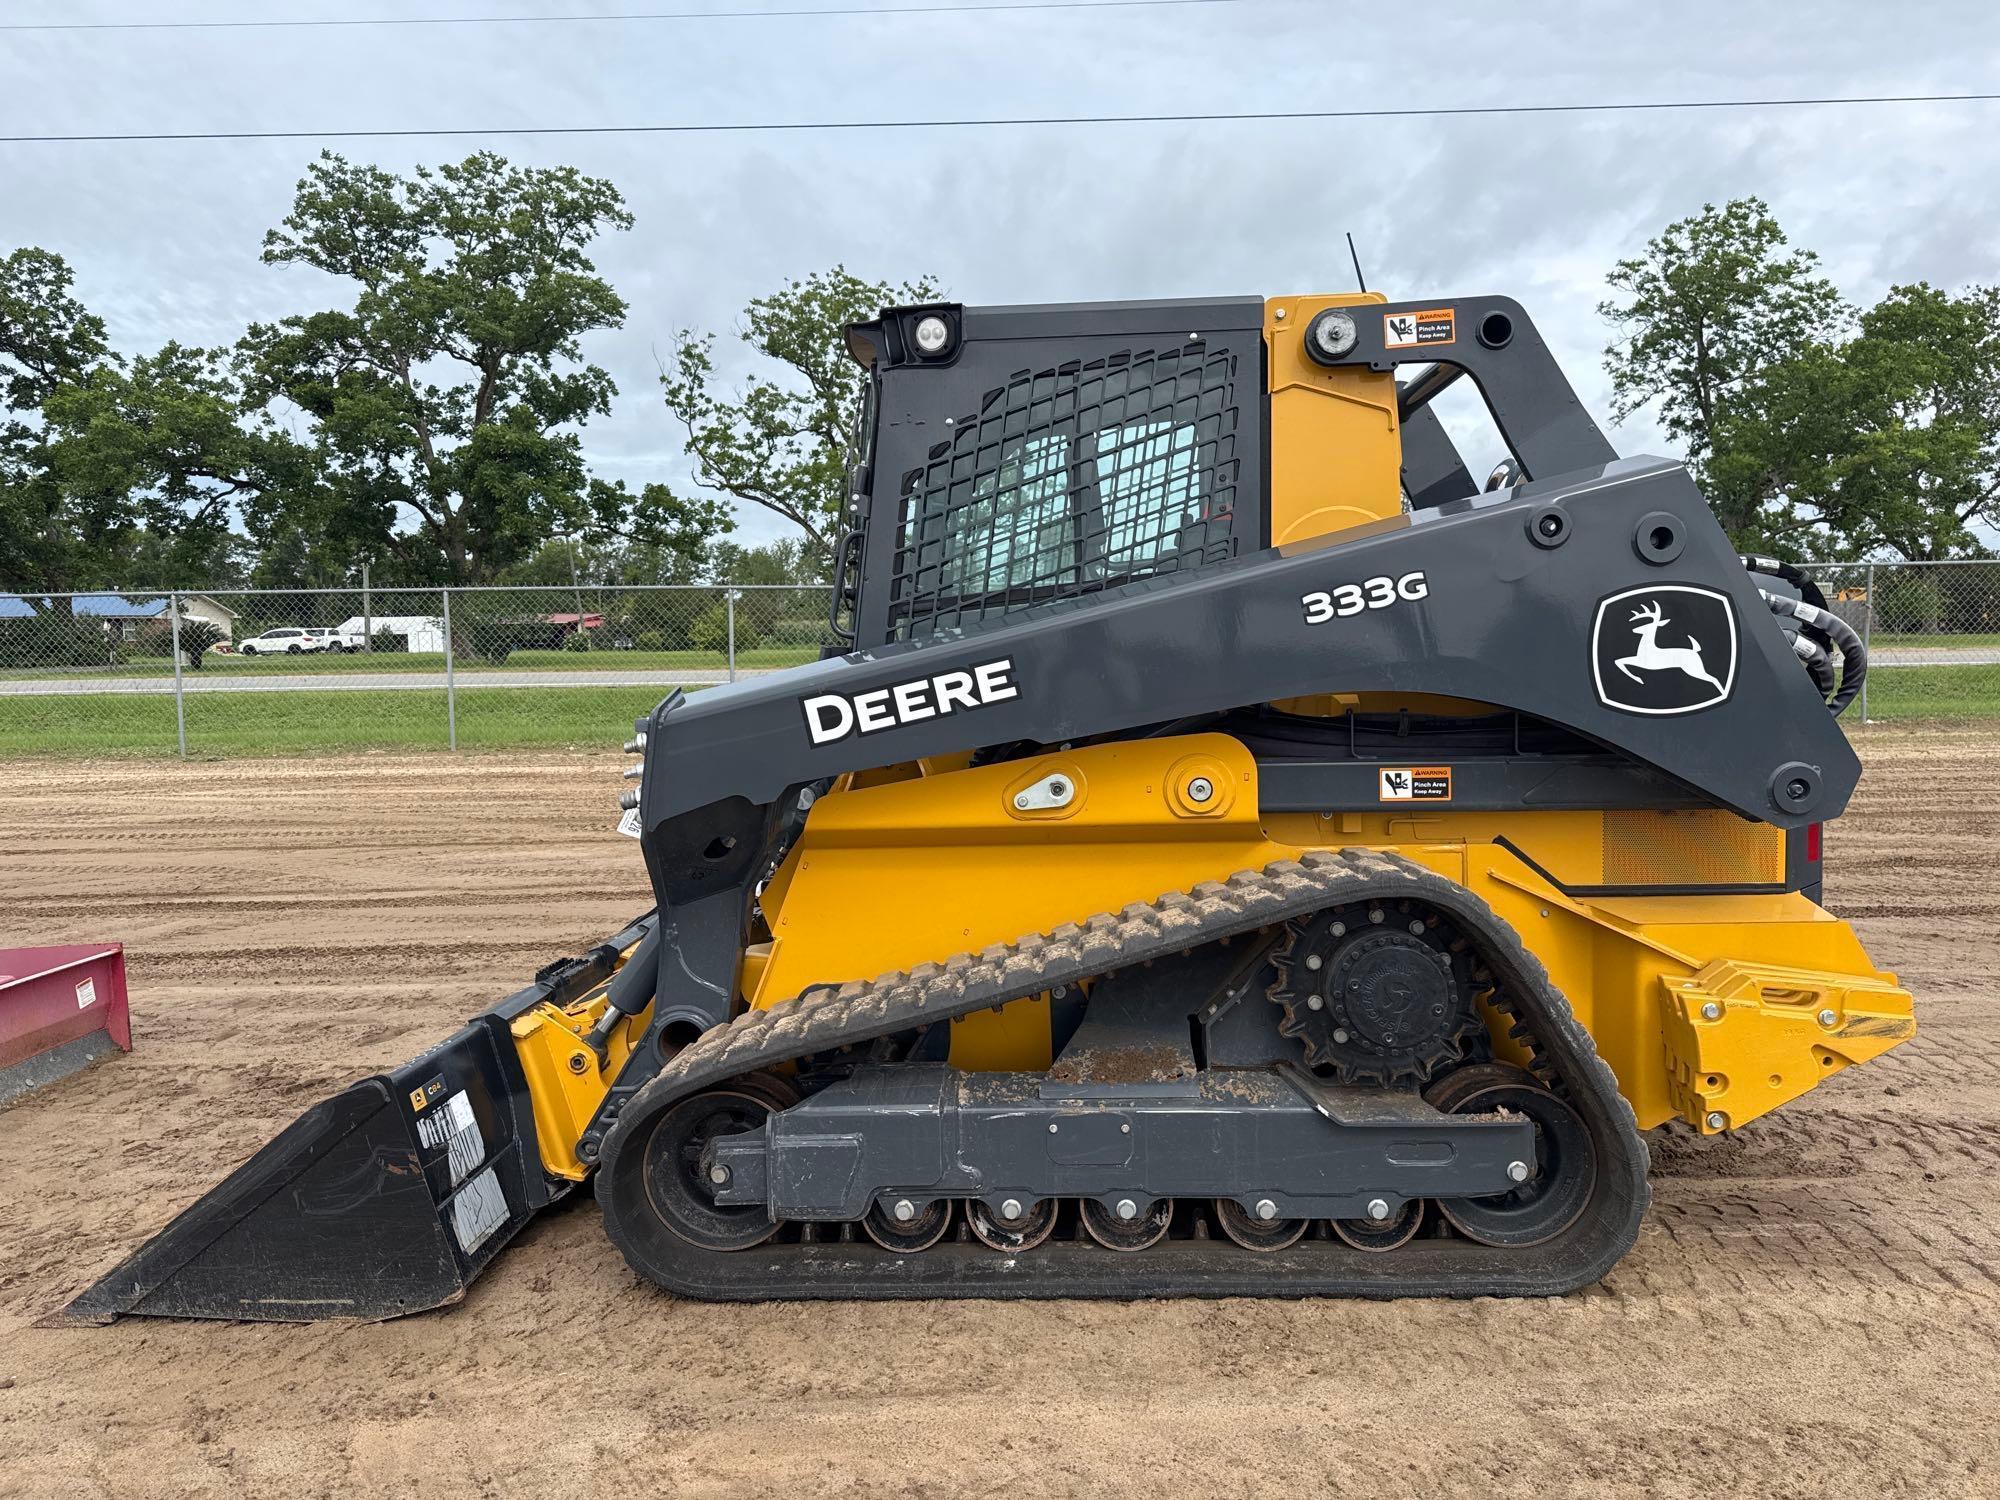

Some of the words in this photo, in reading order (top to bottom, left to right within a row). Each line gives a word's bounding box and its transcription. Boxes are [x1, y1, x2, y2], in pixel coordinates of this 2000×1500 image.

[1424, 312, 1451, 320] WARNING
[1301, 571, 1429, 624] 333G
[803, 659, 1018, 744] DEERE
